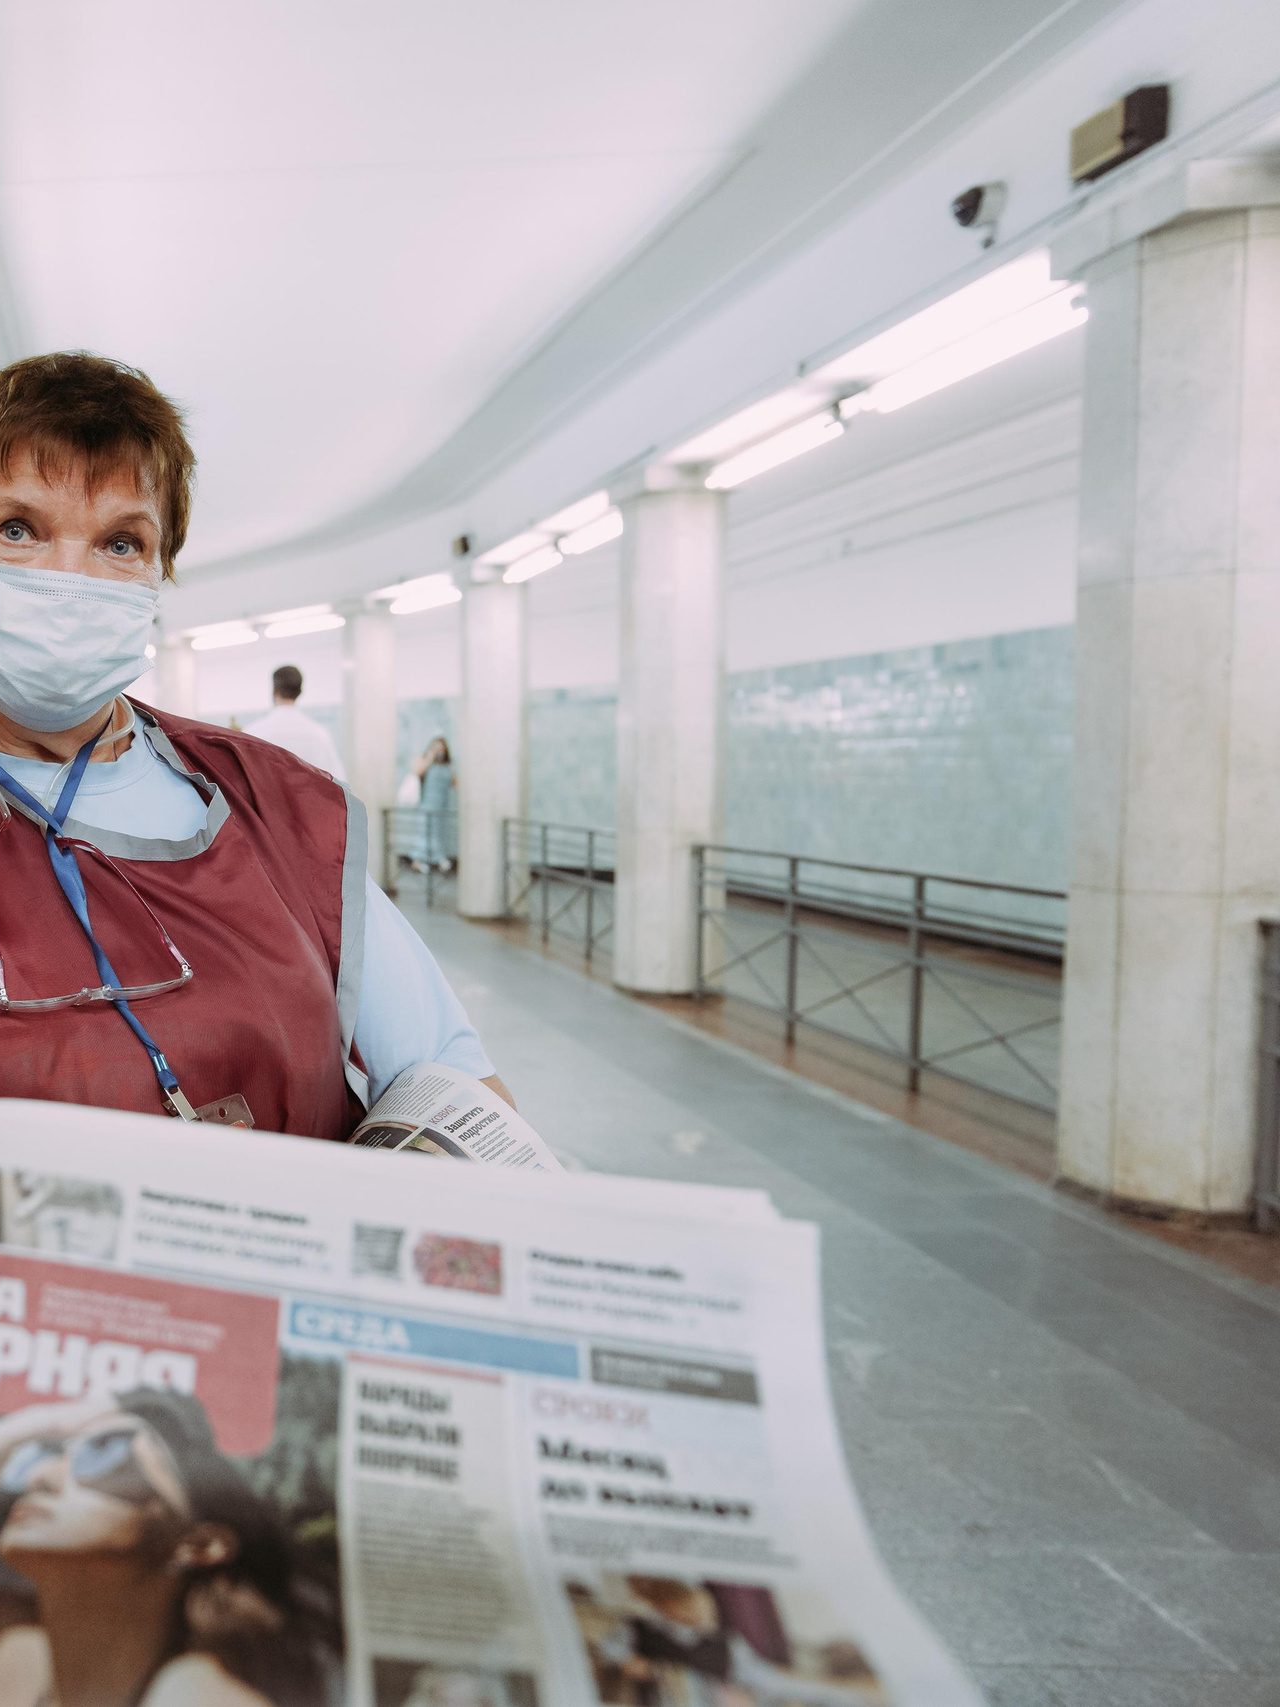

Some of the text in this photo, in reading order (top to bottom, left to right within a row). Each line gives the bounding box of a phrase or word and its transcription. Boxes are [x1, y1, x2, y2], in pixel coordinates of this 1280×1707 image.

[428, 1104, 459, 1125] КОВИД
[443, 1106, 484, 1134] Защитить
[458, 1111, 500, 1142] подростков
[294, 1306, 410, 1350] СРЕДА
